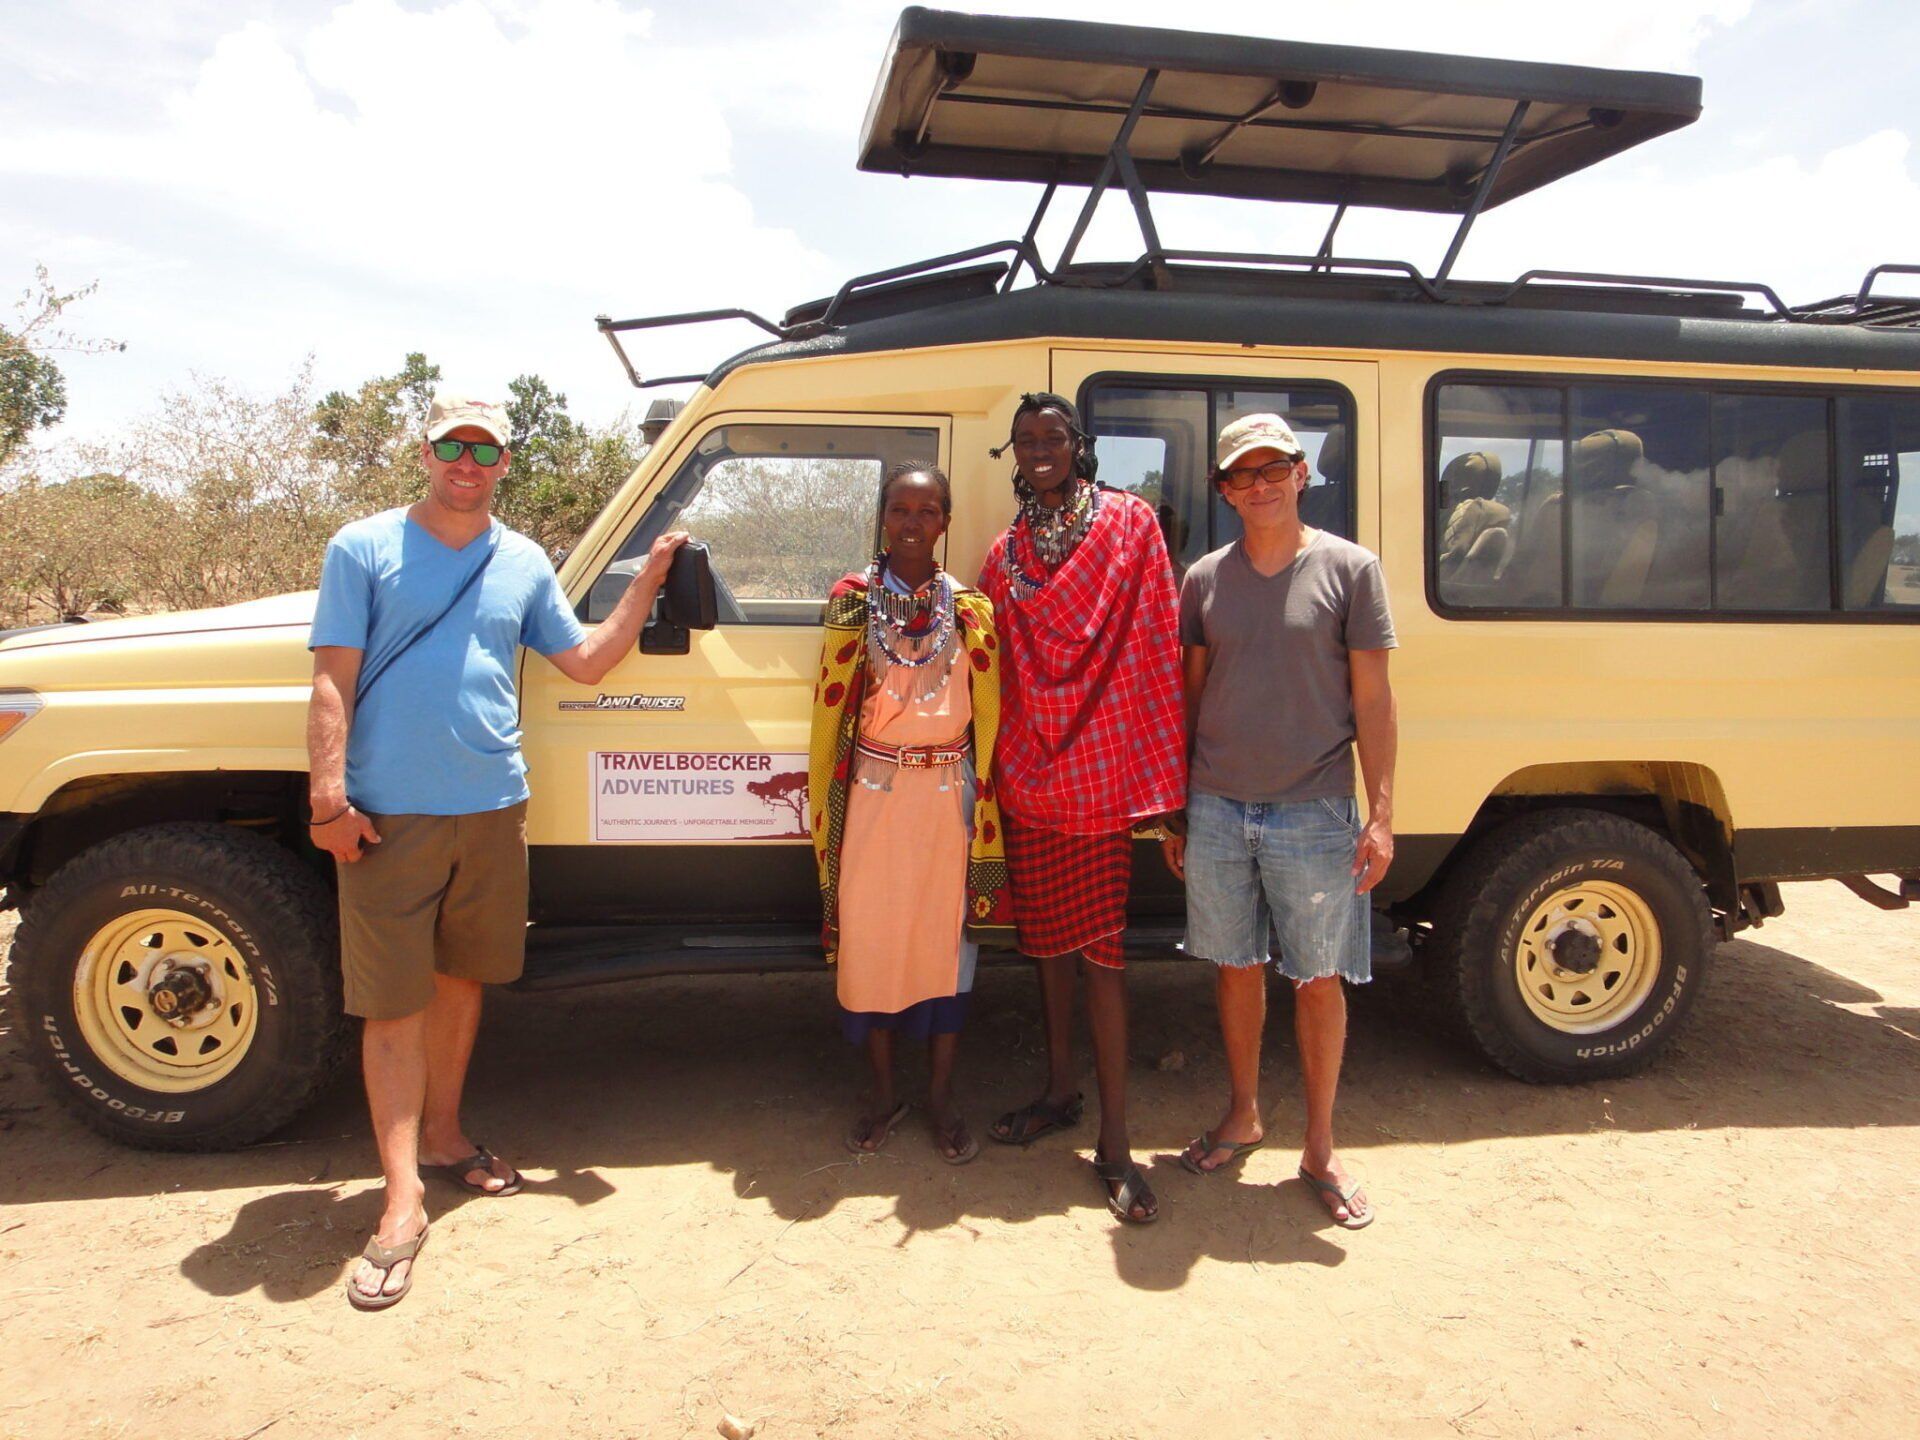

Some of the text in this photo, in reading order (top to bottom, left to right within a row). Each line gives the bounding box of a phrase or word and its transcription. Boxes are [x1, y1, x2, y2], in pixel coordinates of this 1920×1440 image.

[601, 754, 771, 771] TRAVELBOECKER
[602, 779, 734, 795] ADVENTURES
[643, 818, 677, 826] JOURNEYS
[683, 818, 737, 826] UNFORGETTABLE
[1591, 858, 1626, 871] T/A
[120, 884, 279, 1006] All-Terrain T/A
